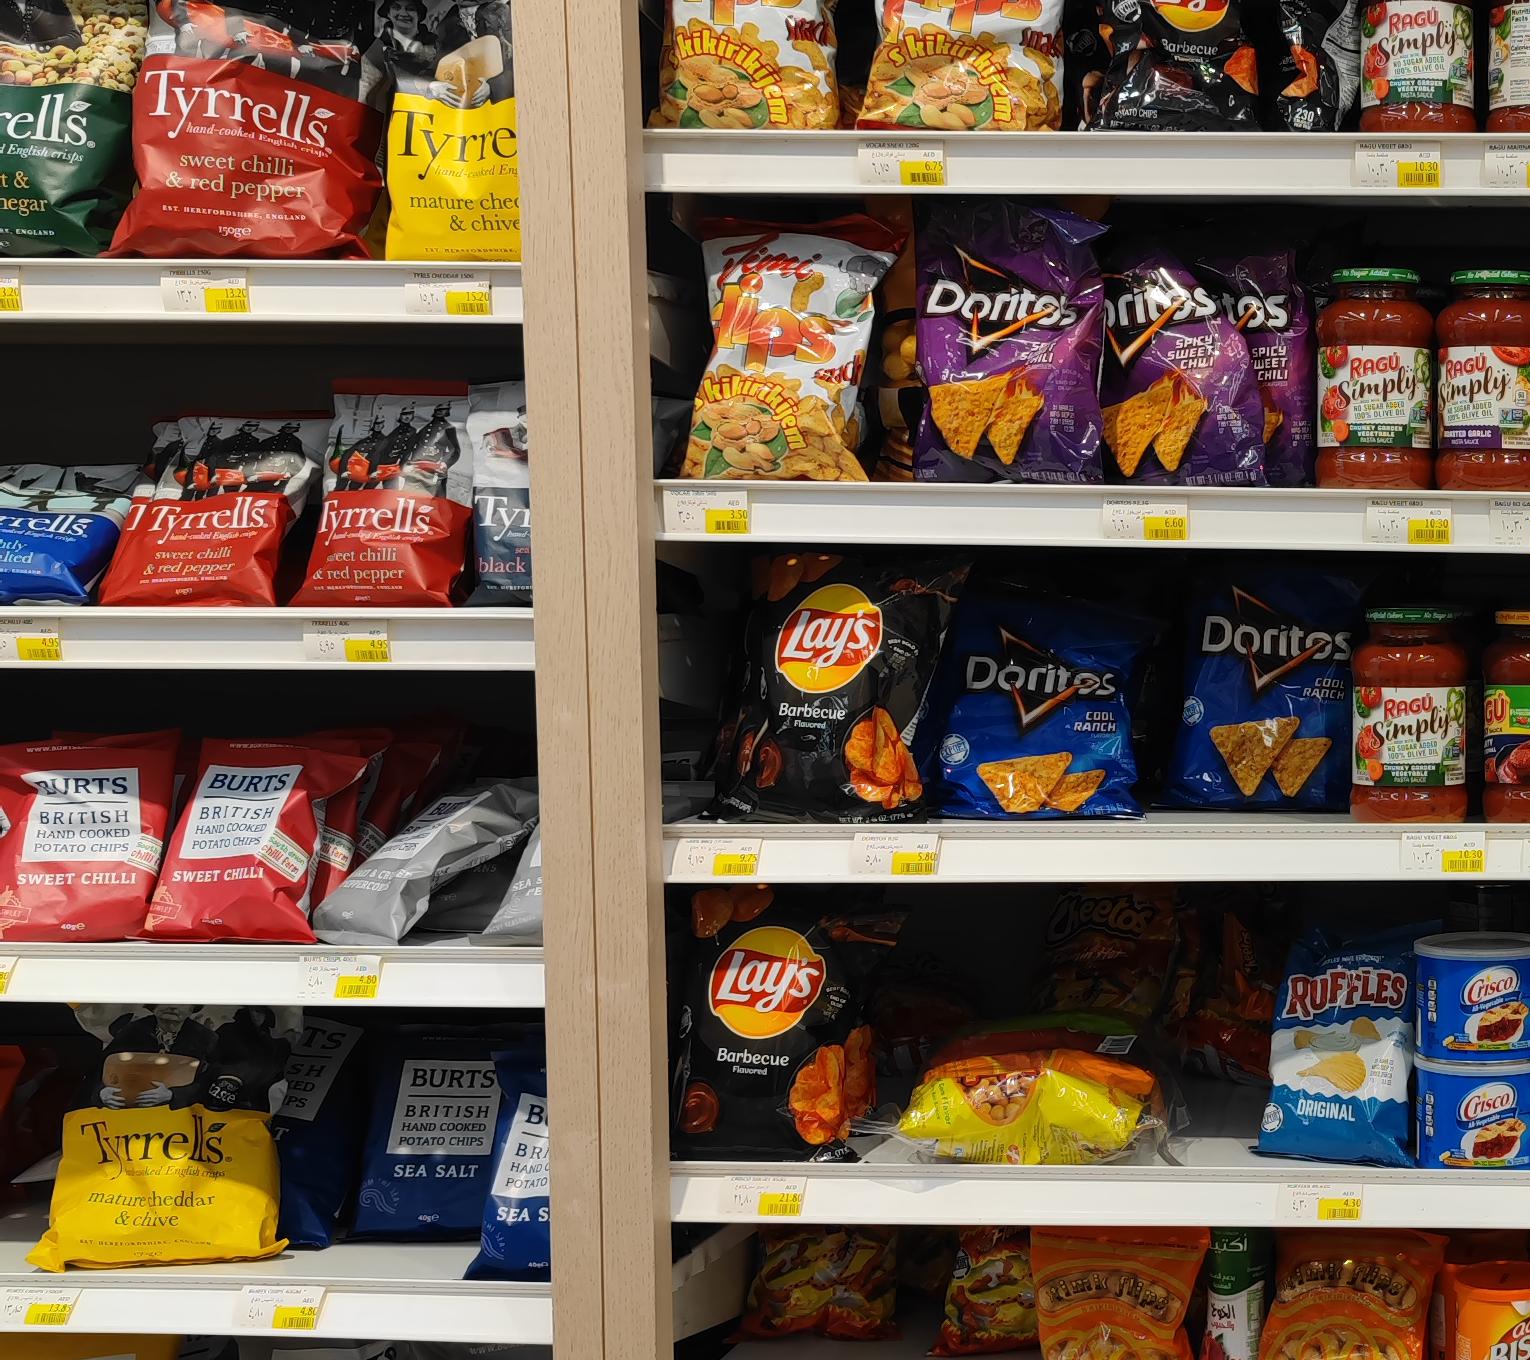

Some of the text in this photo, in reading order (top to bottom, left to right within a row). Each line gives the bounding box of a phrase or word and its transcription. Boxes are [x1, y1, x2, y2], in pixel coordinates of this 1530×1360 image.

[1161, 40, 1218, 55] Barbecue
[909, 33, 1011, 123] kikirikijem
[180, 152, 294, 175] sweet chilli
[925, 161, 943, 170] 6.75
[1415, 163, 1438, 172] 10.30
[190, 172, 305, 200] red pepper
[1351, 353, 1399, 376] RAGÚ
[729, 510, 747, 519] 3.50
[194, 547, 231, 560] chilli
[782, 609, 872, 666] Lay's
[1203, 615, 1351, 663] Doritos
[965, 655, 1116, 699] Doritos
[778, 702, 846, 721] Barbecue
[1085, 711, 1115, 721] COOL
[794, 720, 826, 729] Flavored
[206, 774, 290, 792] BURTS
[41, 809, 129, 824] BRITISH
[36, 828, 128, 840] HAND COOKED
[35, 841, 129, 854] POTATO CHIPS
[17, 871, 136, 886] SWEET CHILLI
[172, 869, 219, 882] SWEET
[717, 952, 819, 1011] Lay's
[1465, 972, 1514, 1004] Crisco
[1287, 971, 1406, 1019] RUFFLES
[404, 1104, 489, 1119] BRITISH
[1297, 1099, 1355, 1122] ORIGINAL
[401, 1121, 486, 1132] HAND COOKED
[399, 1135, 483, 1148] POTATO CHIPS
[394, 1164, 478, 1179] SEA SALT
